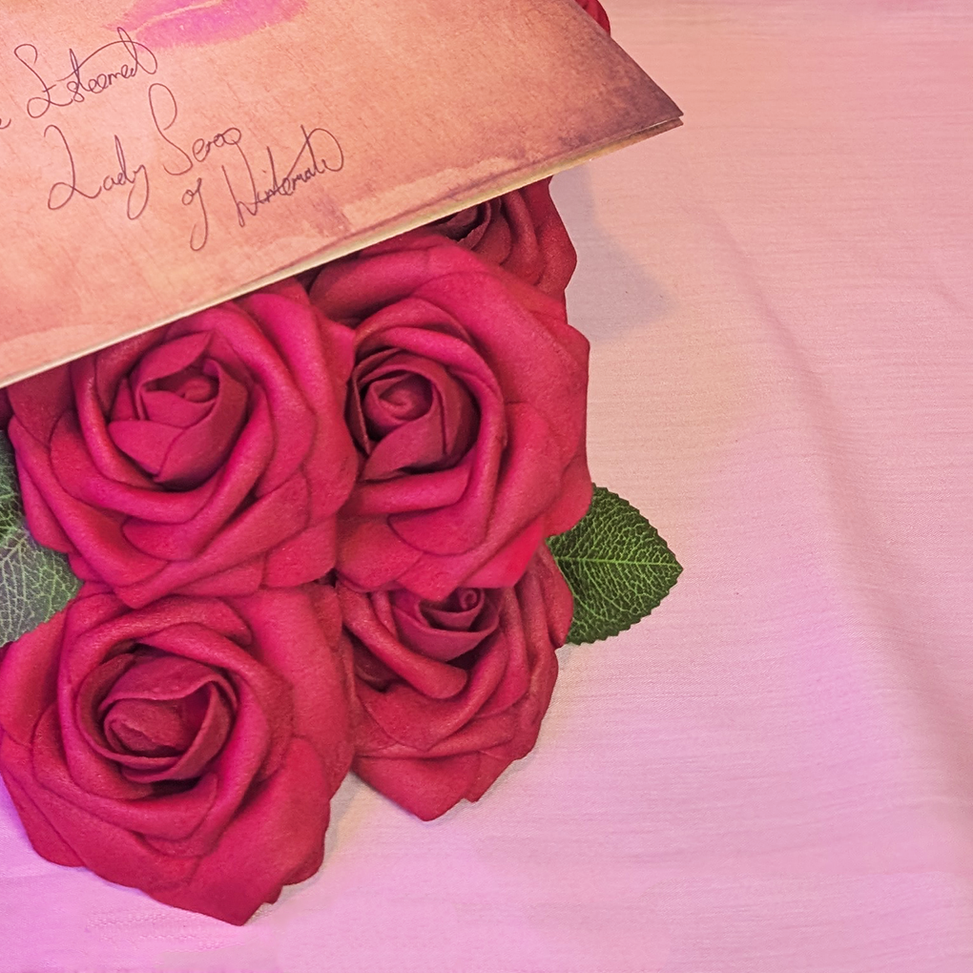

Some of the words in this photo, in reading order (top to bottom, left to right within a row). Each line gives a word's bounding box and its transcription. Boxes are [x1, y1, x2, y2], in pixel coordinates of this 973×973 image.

[13, 27, 158, 119] Esteemed
[44, 124, 150, 221] Lady
[181, 177, 209, 252] of
